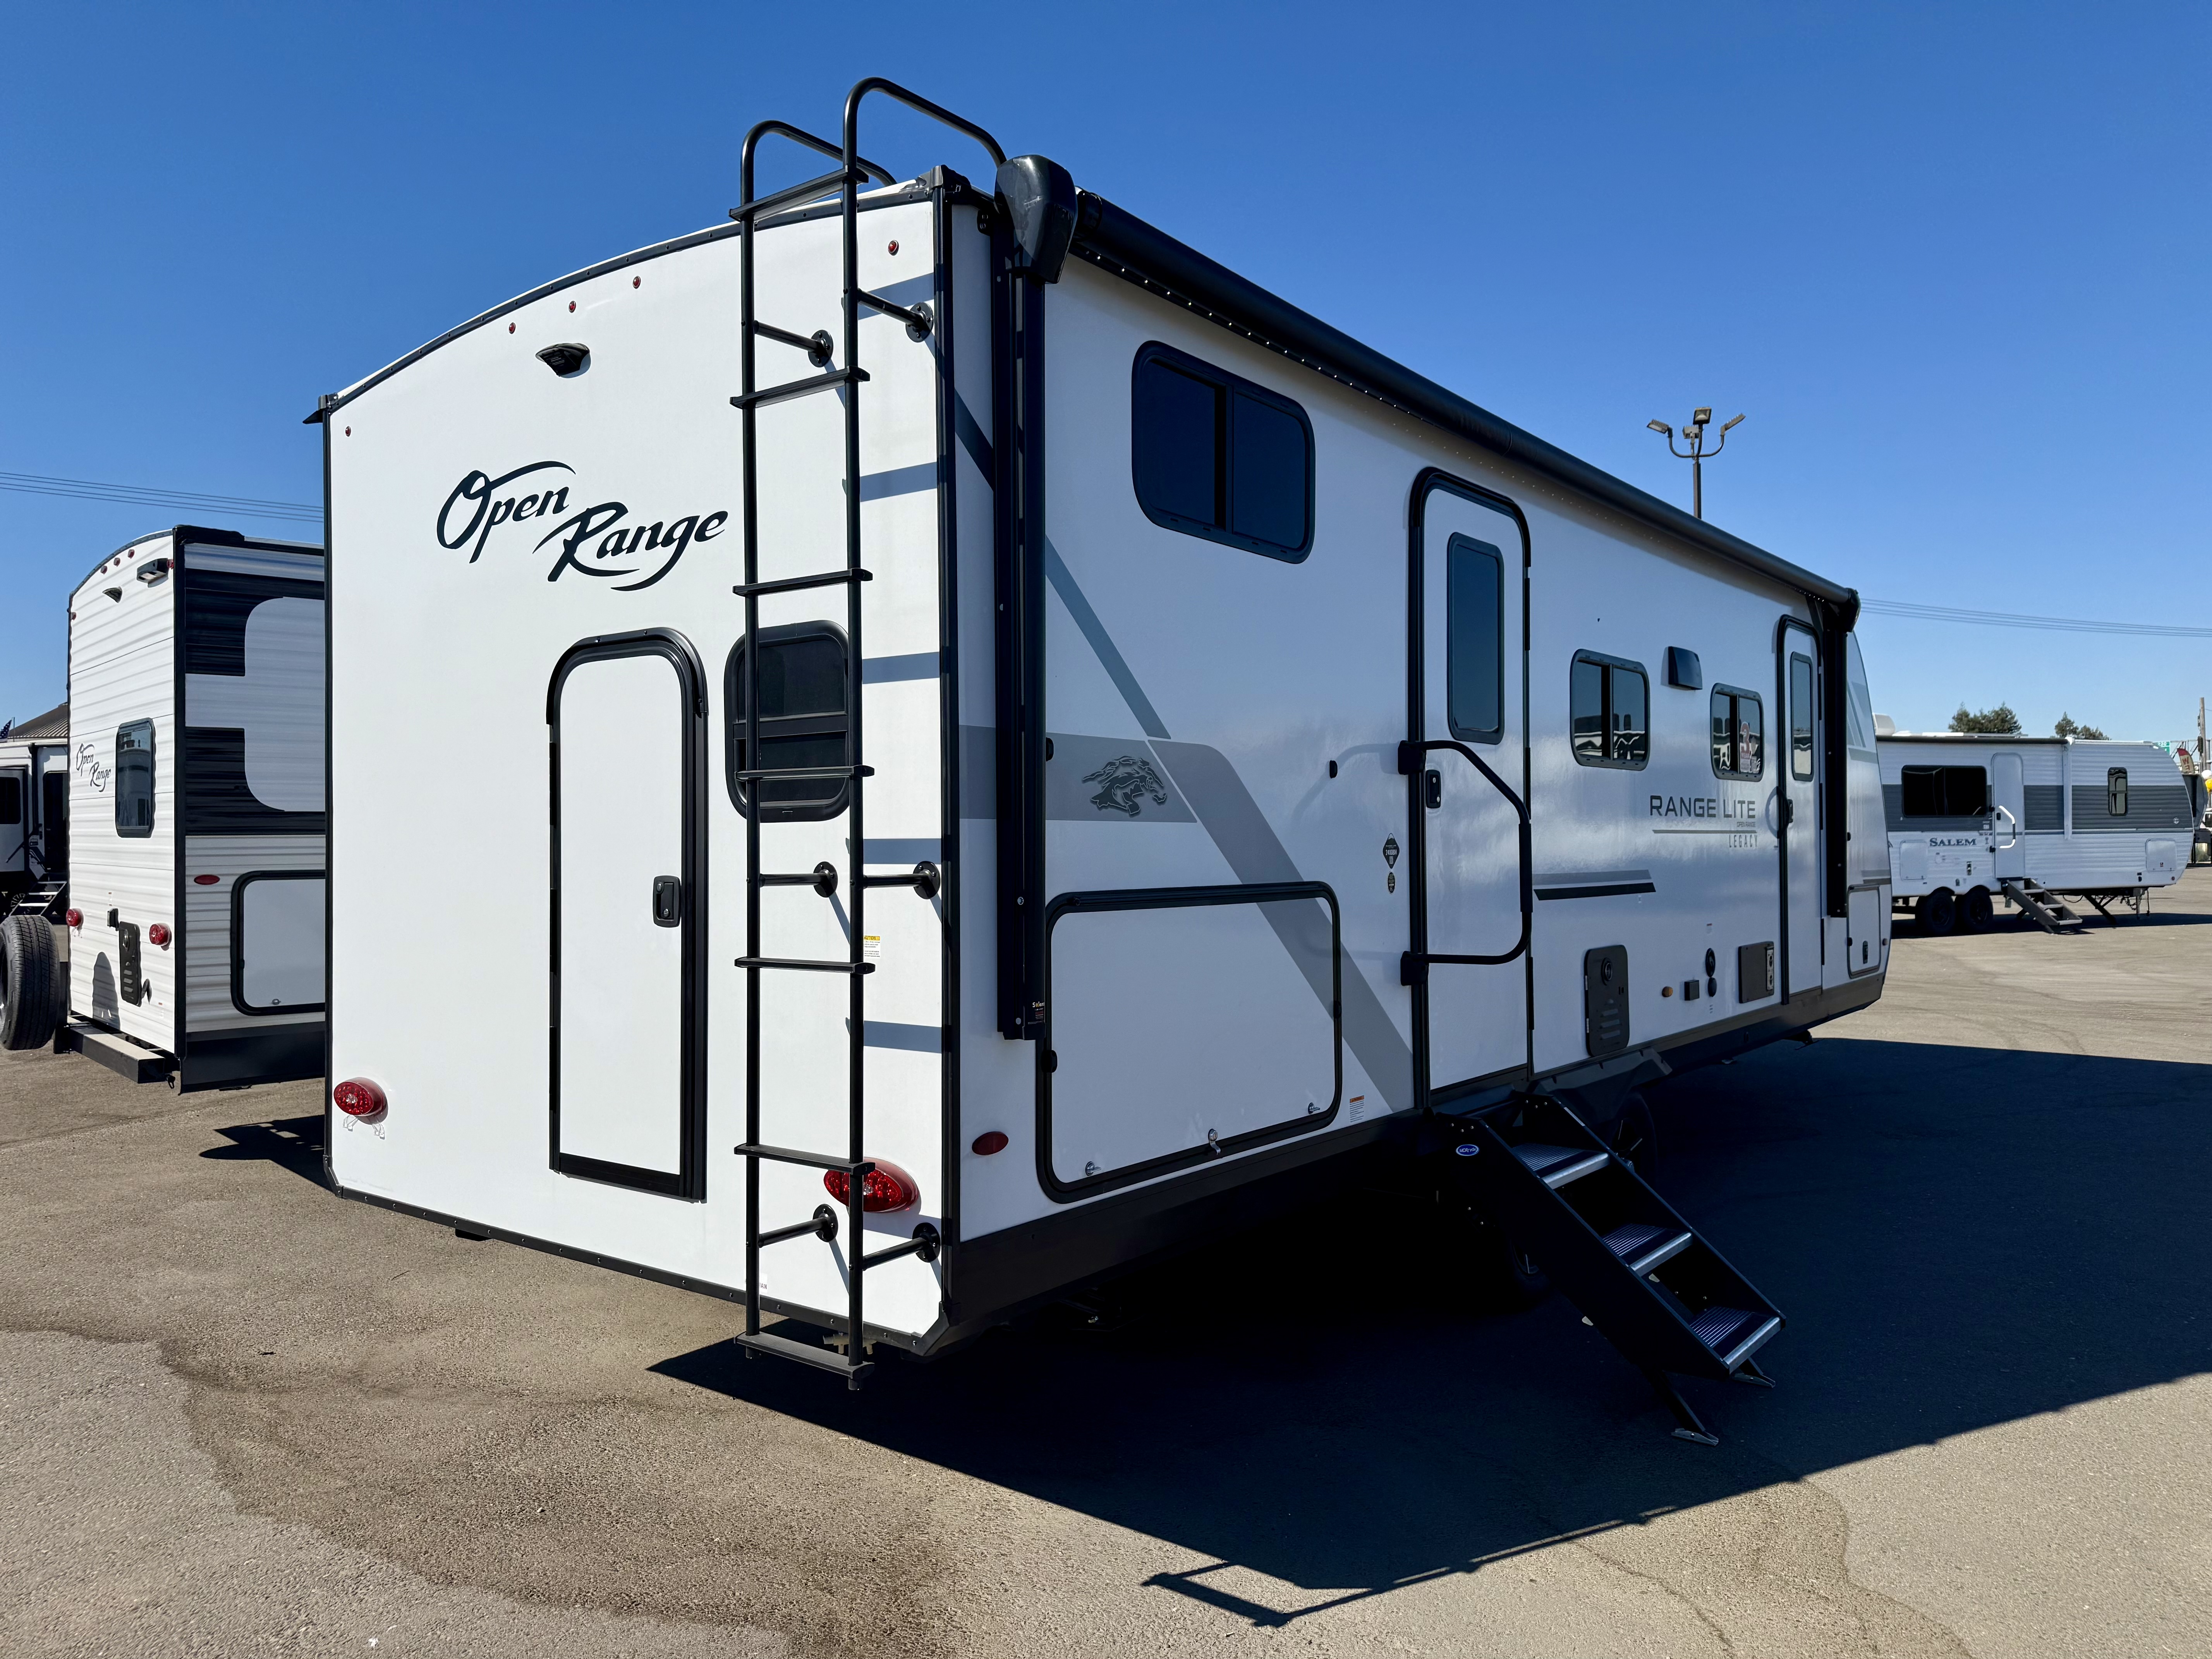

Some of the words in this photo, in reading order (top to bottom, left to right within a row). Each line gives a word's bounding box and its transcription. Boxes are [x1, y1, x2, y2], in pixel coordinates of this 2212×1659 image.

[436, 460, 576, 563] Open
[532, 501, 728, 591] Range
[76, 743, 94, 777] Open
[88, 761, 111, 792] Range
[1650, 795, 1716, 817] RANGE
[1723, 799, 1756, 819] LITE
[1729, 834, 1758, 848] LEGACY
[1930, 837, 1977, 847] SALEM
